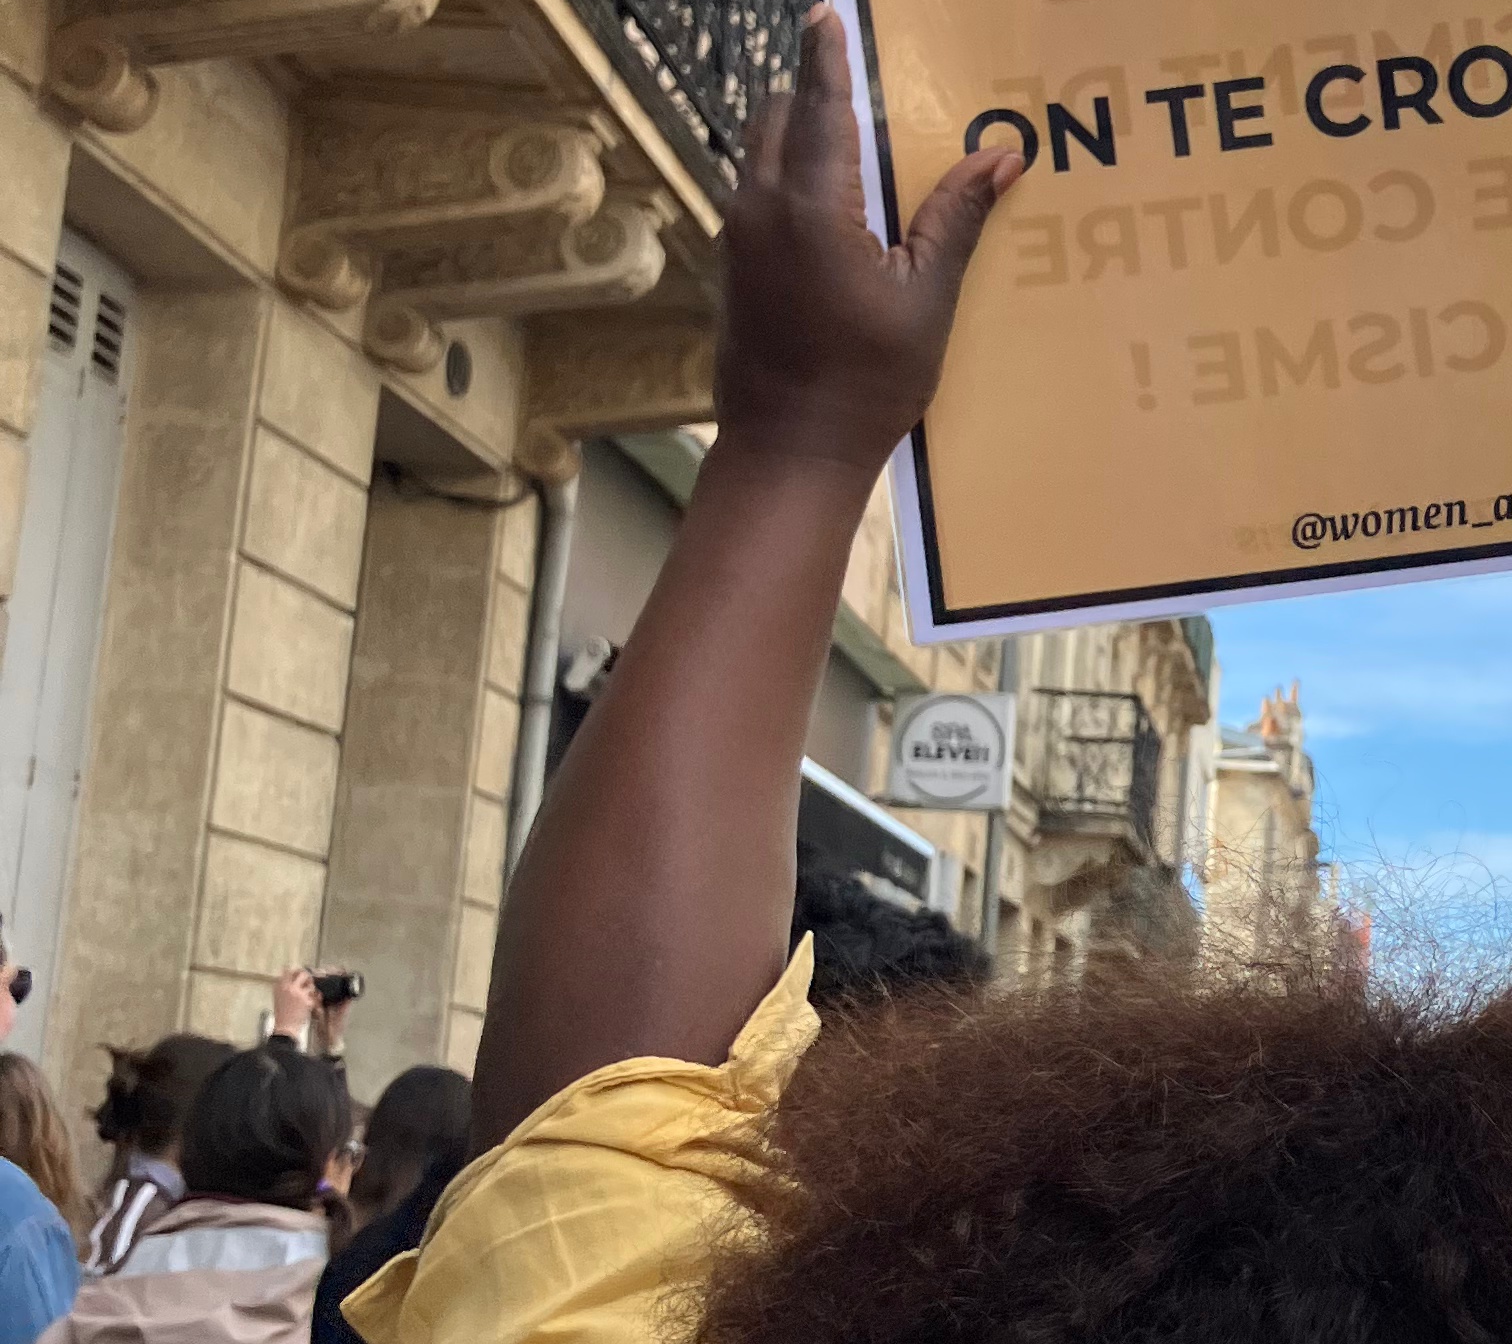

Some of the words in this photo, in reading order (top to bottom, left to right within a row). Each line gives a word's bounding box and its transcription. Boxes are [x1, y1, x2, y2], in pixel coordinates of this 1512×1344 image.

[964, 98, 1116, 173] ON
[1146, 77, 1273, 157] TE
[912, 742, 989, 762] ELEVEN
